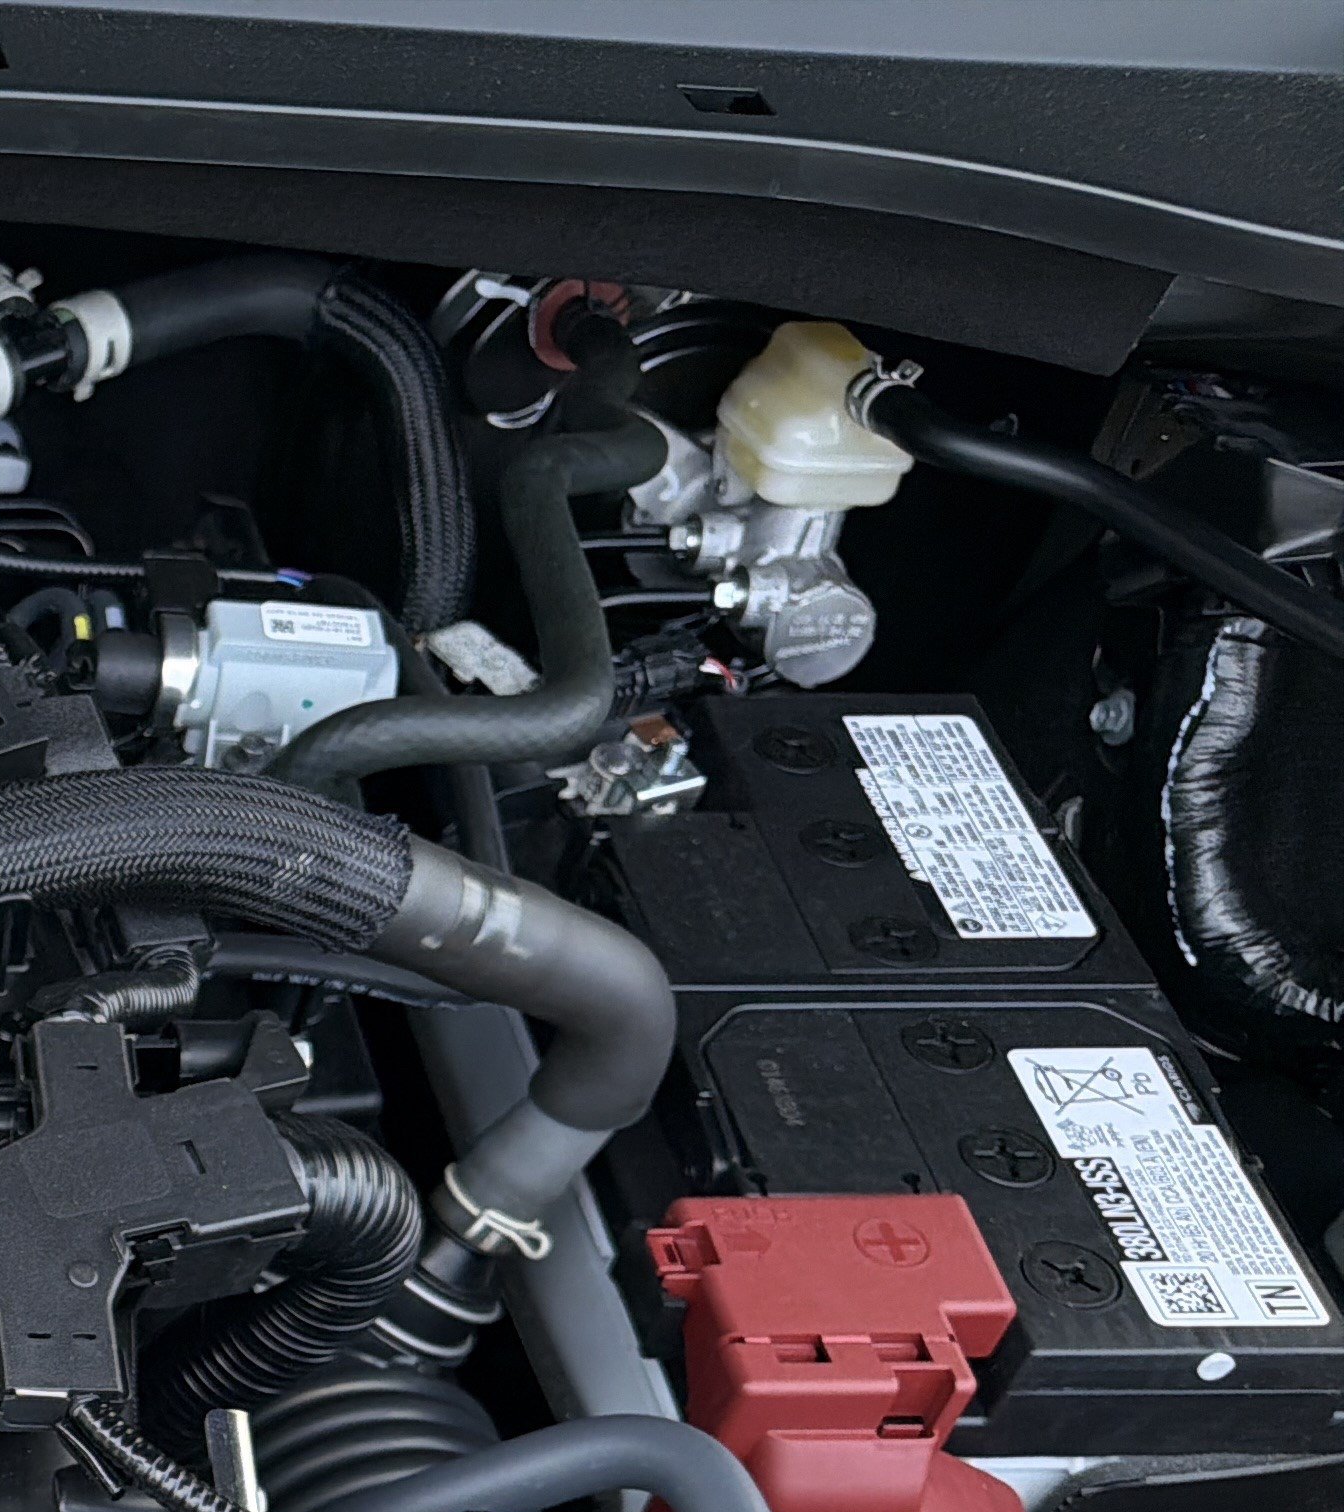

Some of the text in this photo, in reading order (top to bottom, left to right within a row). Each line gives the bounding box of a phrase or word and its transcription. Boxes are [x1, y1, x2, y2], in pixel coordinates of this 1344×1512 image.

[1125, 1072, 1159, 1095] Pb
[1154, 1054, 1194, 1101] CLARIOS
[1071, 1158, 1165, 1259] 380LN3-ISS
[1253, 1284, 1312, 1315] TN
